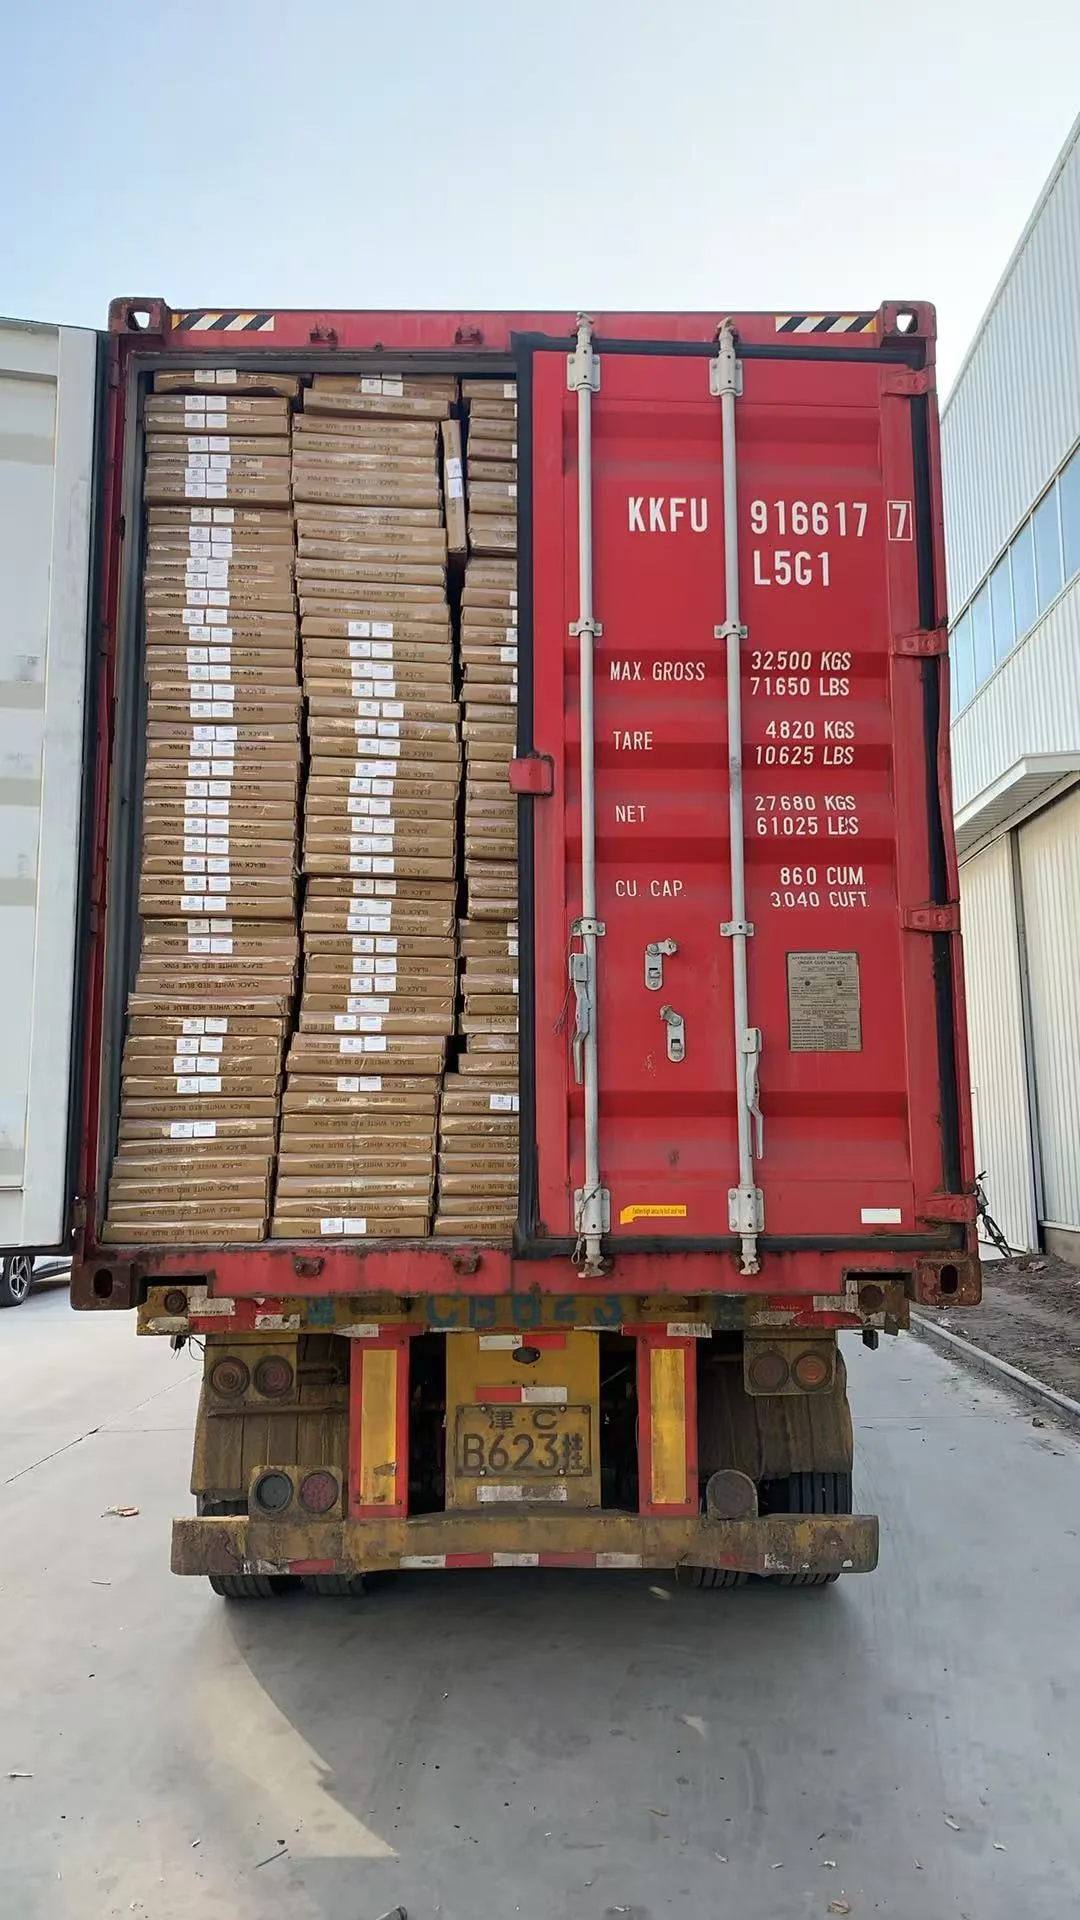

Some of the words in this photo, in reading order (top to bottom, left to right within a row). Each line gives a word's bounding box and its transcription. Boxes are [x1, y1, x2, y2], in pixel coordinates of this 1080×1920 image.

[628, 497, 708, 532] KKFU
[751, 500, 867, 537] 916617
[892, 504, 907, 538] 7
[754, 550, 829, 587] L5G1
[751, 651, 812, 670] 32.500
[820, 651, 852, 671] KGS
[610, 661, 645, 681] MAX.
[652, 661, 706, 681] GROSS
[750, 677, 810, 696] 71.650
[819, 677, 850, 696] LBS
[765, 720, 815, 739] 4.820
[824, 721, 855, 739] KGS
[613, 731, 654, 751] TARE
[755, 745, 814, 765] 10.625
[823, 745, 855, 765] LBS
[754, 795, 816, 811] 27.680
[824, 795, 856, 811] KGS
[615, 805, 647, 823] NET
[757, 816, 818, 835] 61.025
[827, 816, 859, 835] LBS
[780, 866, 817, 885] 86.0
[770, 891, 820, 908] 3.040
